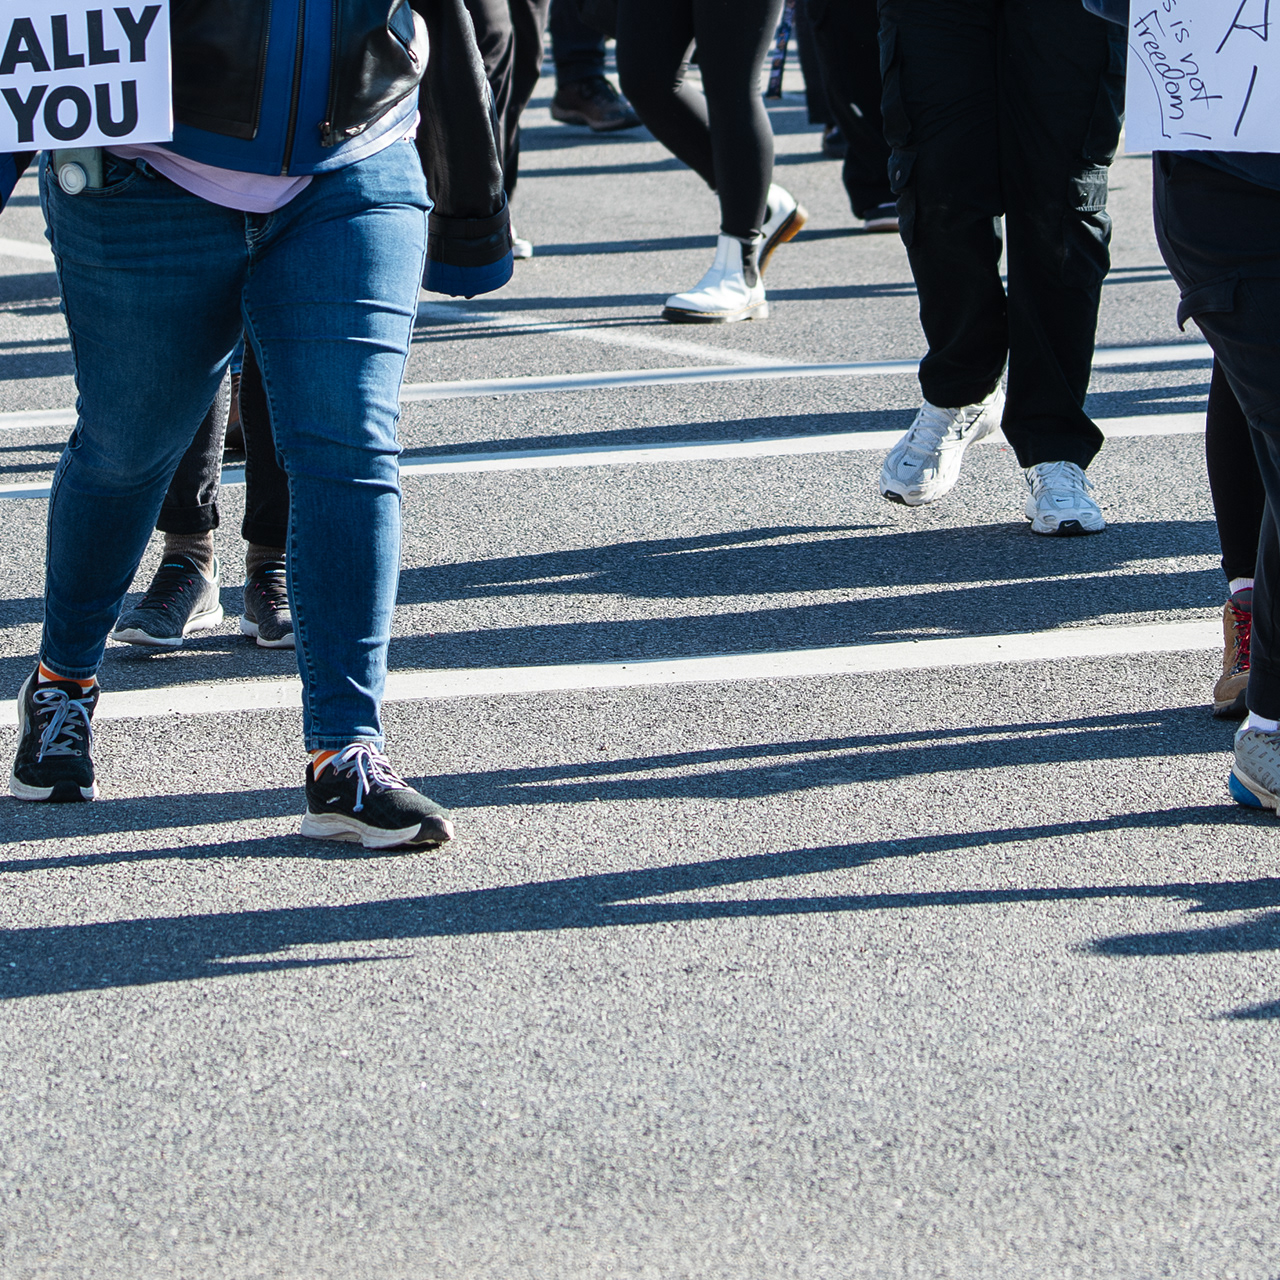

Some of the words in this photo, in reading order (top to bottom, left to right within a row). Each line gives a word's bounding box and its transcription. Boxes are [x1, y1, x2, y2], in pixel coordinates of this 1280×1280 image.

[1170, 20, 1193, 43] is
[1180, 53, 1223, 109] not
[2, 79, 140, 143] YOU
